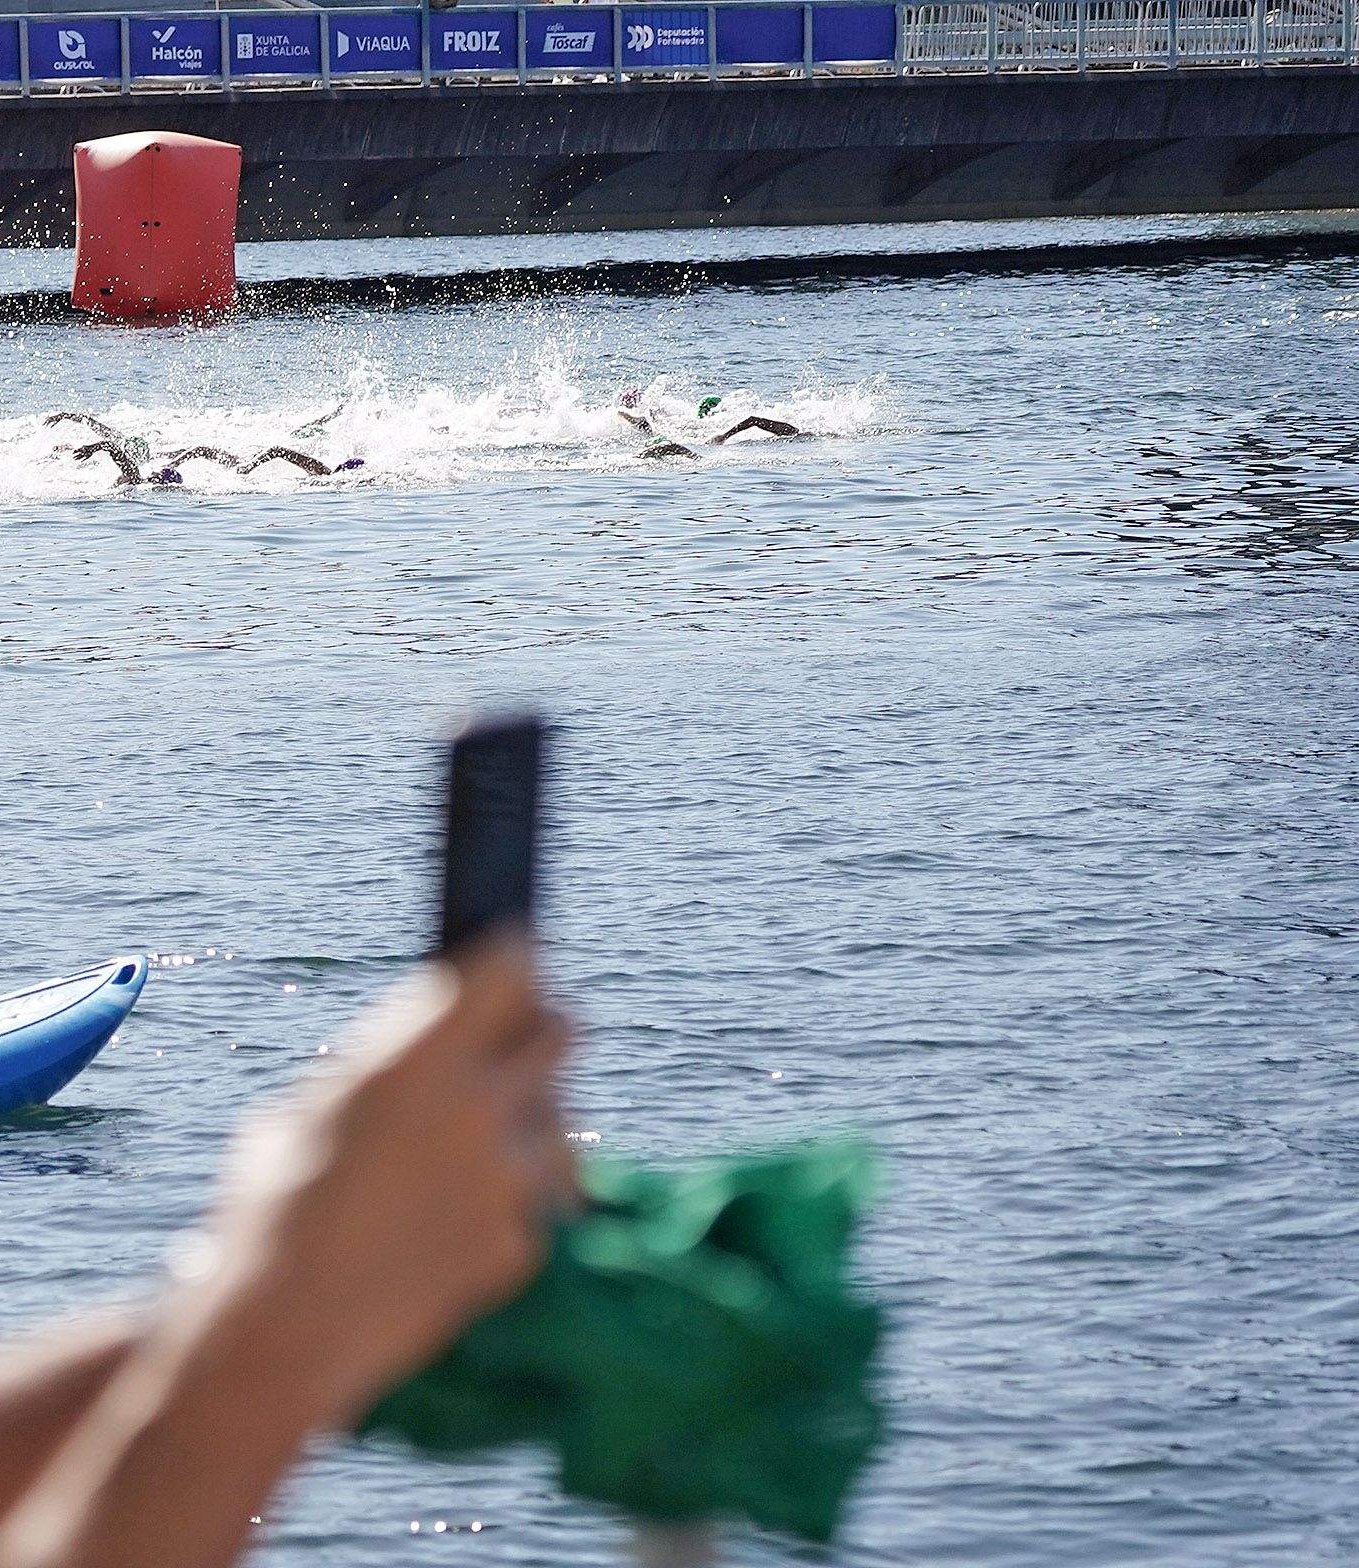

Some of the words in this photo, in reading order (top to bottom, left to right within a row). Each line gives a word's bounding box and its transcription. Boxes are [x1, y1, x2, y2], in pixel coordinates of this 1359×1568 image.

[657, 26, 705, 38] Deputación
[255, 35, 290, 46] XUNTA
[443, 31, 500, 52] FROIZ
[550, 35, 590, 50] Toscaf
[657, 36, 705, 46] Pontevedra
[152, 46, 203, 61] Halcón
[255, 46, 269, 57] DE
[271, 46, 311, 57] GALICIA
[178, 60, 203, 70] viajes
